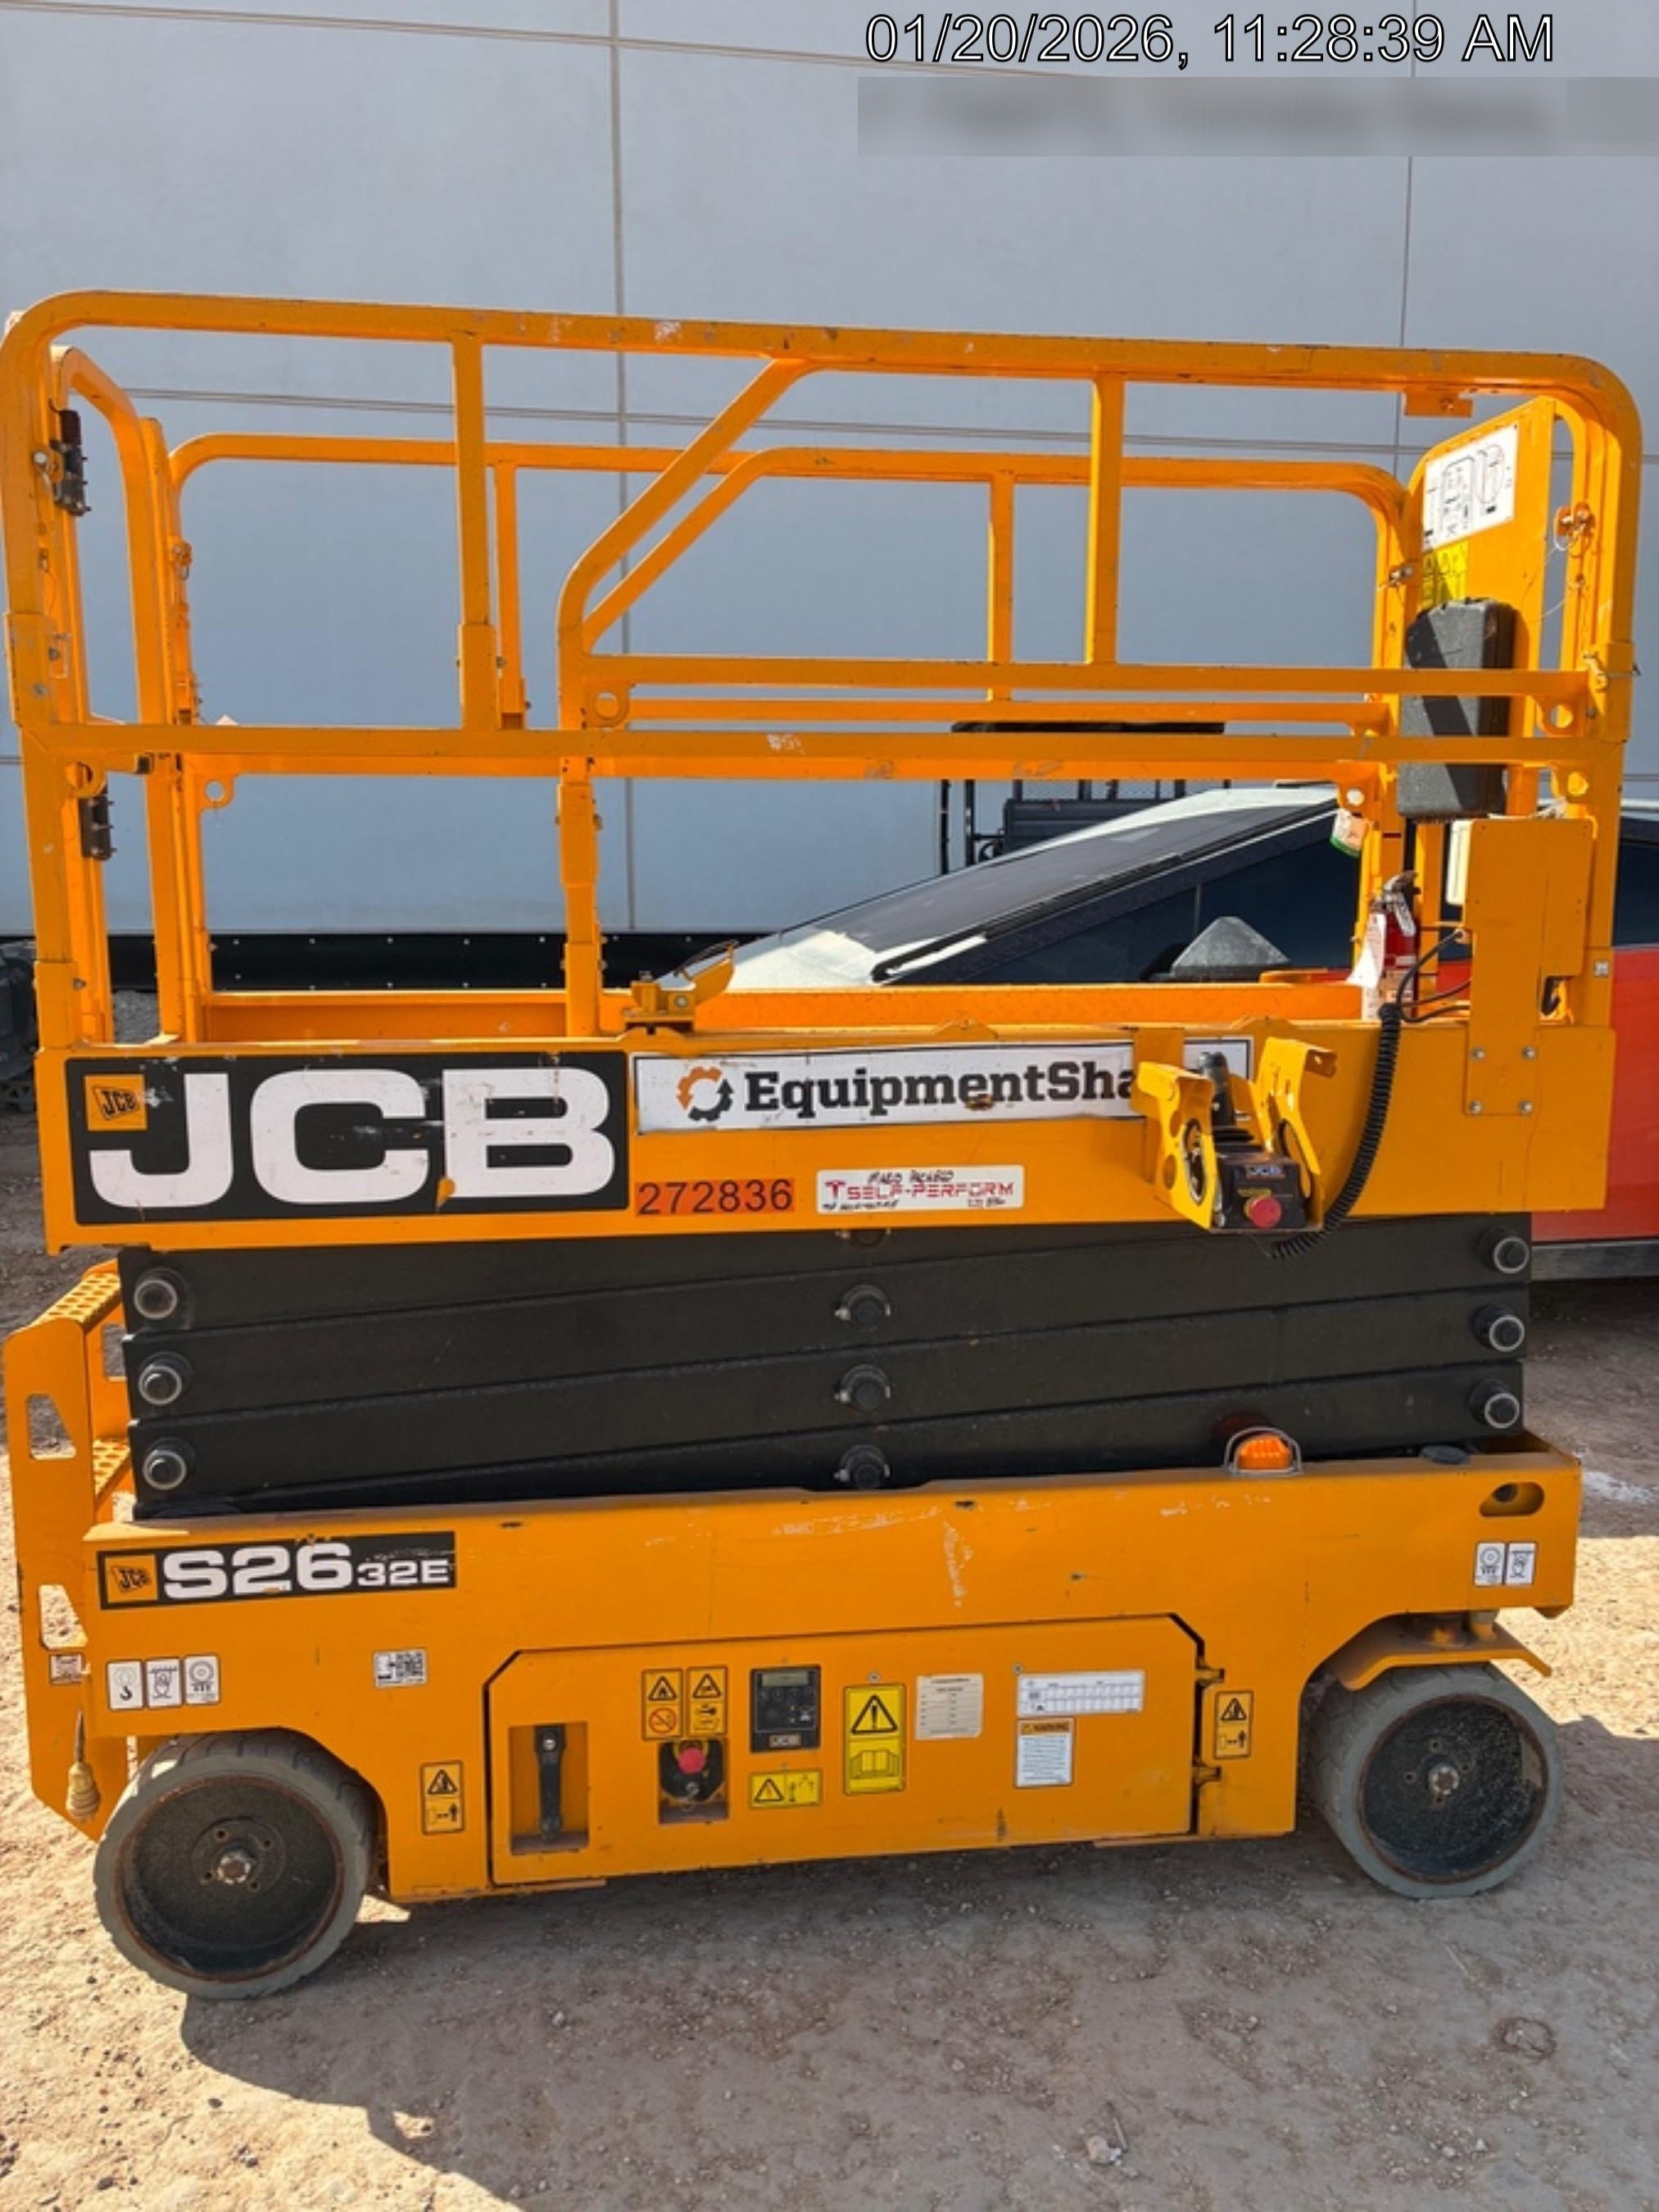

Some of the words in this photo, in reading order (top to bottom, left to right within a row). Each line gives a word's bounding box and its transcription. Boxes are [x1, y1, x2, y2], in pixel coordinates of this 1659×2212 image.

[96, 1088, 138, 1117] JCB
[745, 1060, 1135, 1118] EquipmentSha
[88, 1067, 616, 1208] JCB
[637, 1180, 793, 1216] 272836
[163, 1542, 353, 1599] S26
[356, 1559, 450, 1587] 32E
